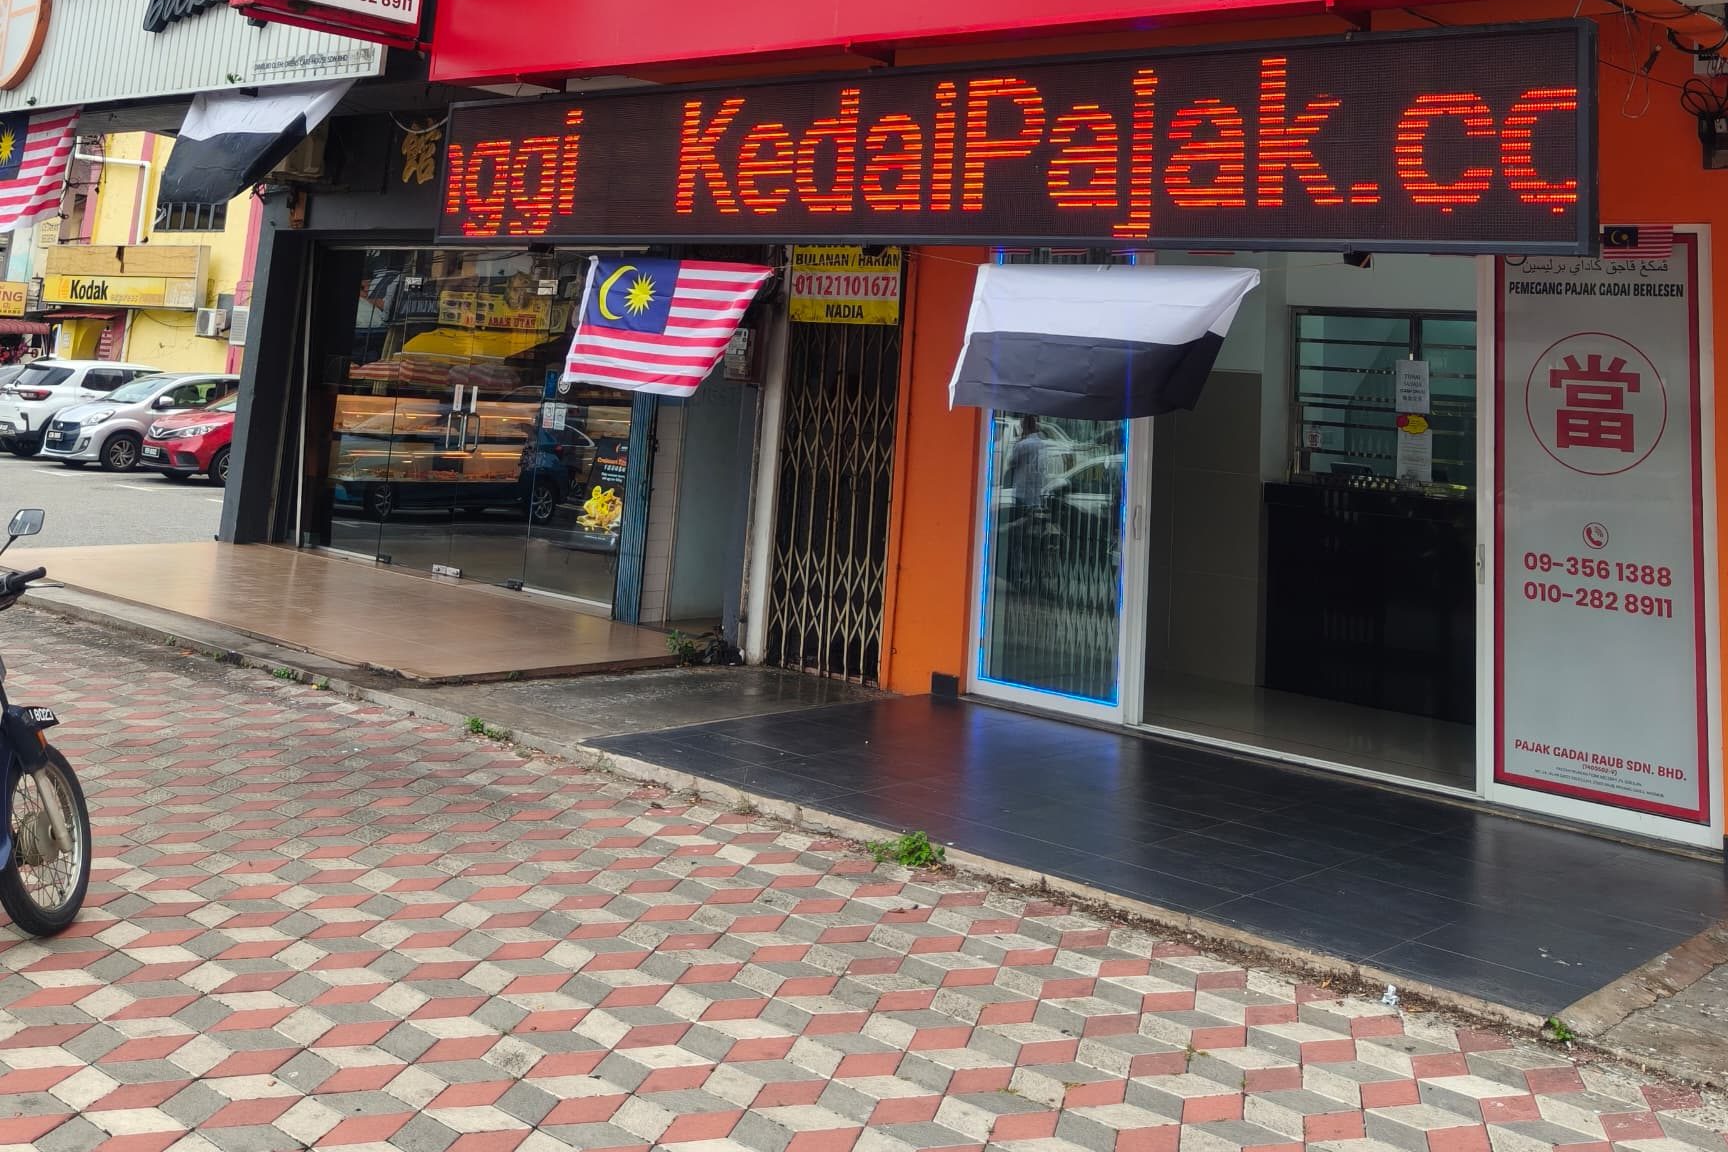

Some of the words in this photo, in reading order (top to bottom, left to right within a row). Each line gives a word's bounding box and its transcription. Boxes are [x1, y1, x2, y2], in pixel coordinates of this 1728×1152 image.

[795, 254, 849, 267] BULANAN
[0, 291, 23, 302] NG
[70, 279, 109, 301] Kodak
[795, 275, 898, 297] 01121101672
[1509, 281, 1563, 295] PEMEGANG
[1565, 282, 1597, 296] PAJAK
[1599, 283, 1631, 297] GADAI
[1633, 283, 1684, 297] BERLESEN
[826, 304, 864, 318] NADIA
[1550, 354, 1640, 453] 當
[1523, 552, 1610, 580] 09-356
[1616, 562, 1673, 588] 1388
[1523, 581, 1618, 611] 010-282
[1624, 595, 1673, 619] 8911
[1514, 738, 1551, 755] PAJAK
[1552, 746, 1589, 762] GADAI
[1591, 753, 1624, 769] RAUB
[1626, 760, 1655, 776] SDN.
[1657, 766, 1688, 781] BHD.
